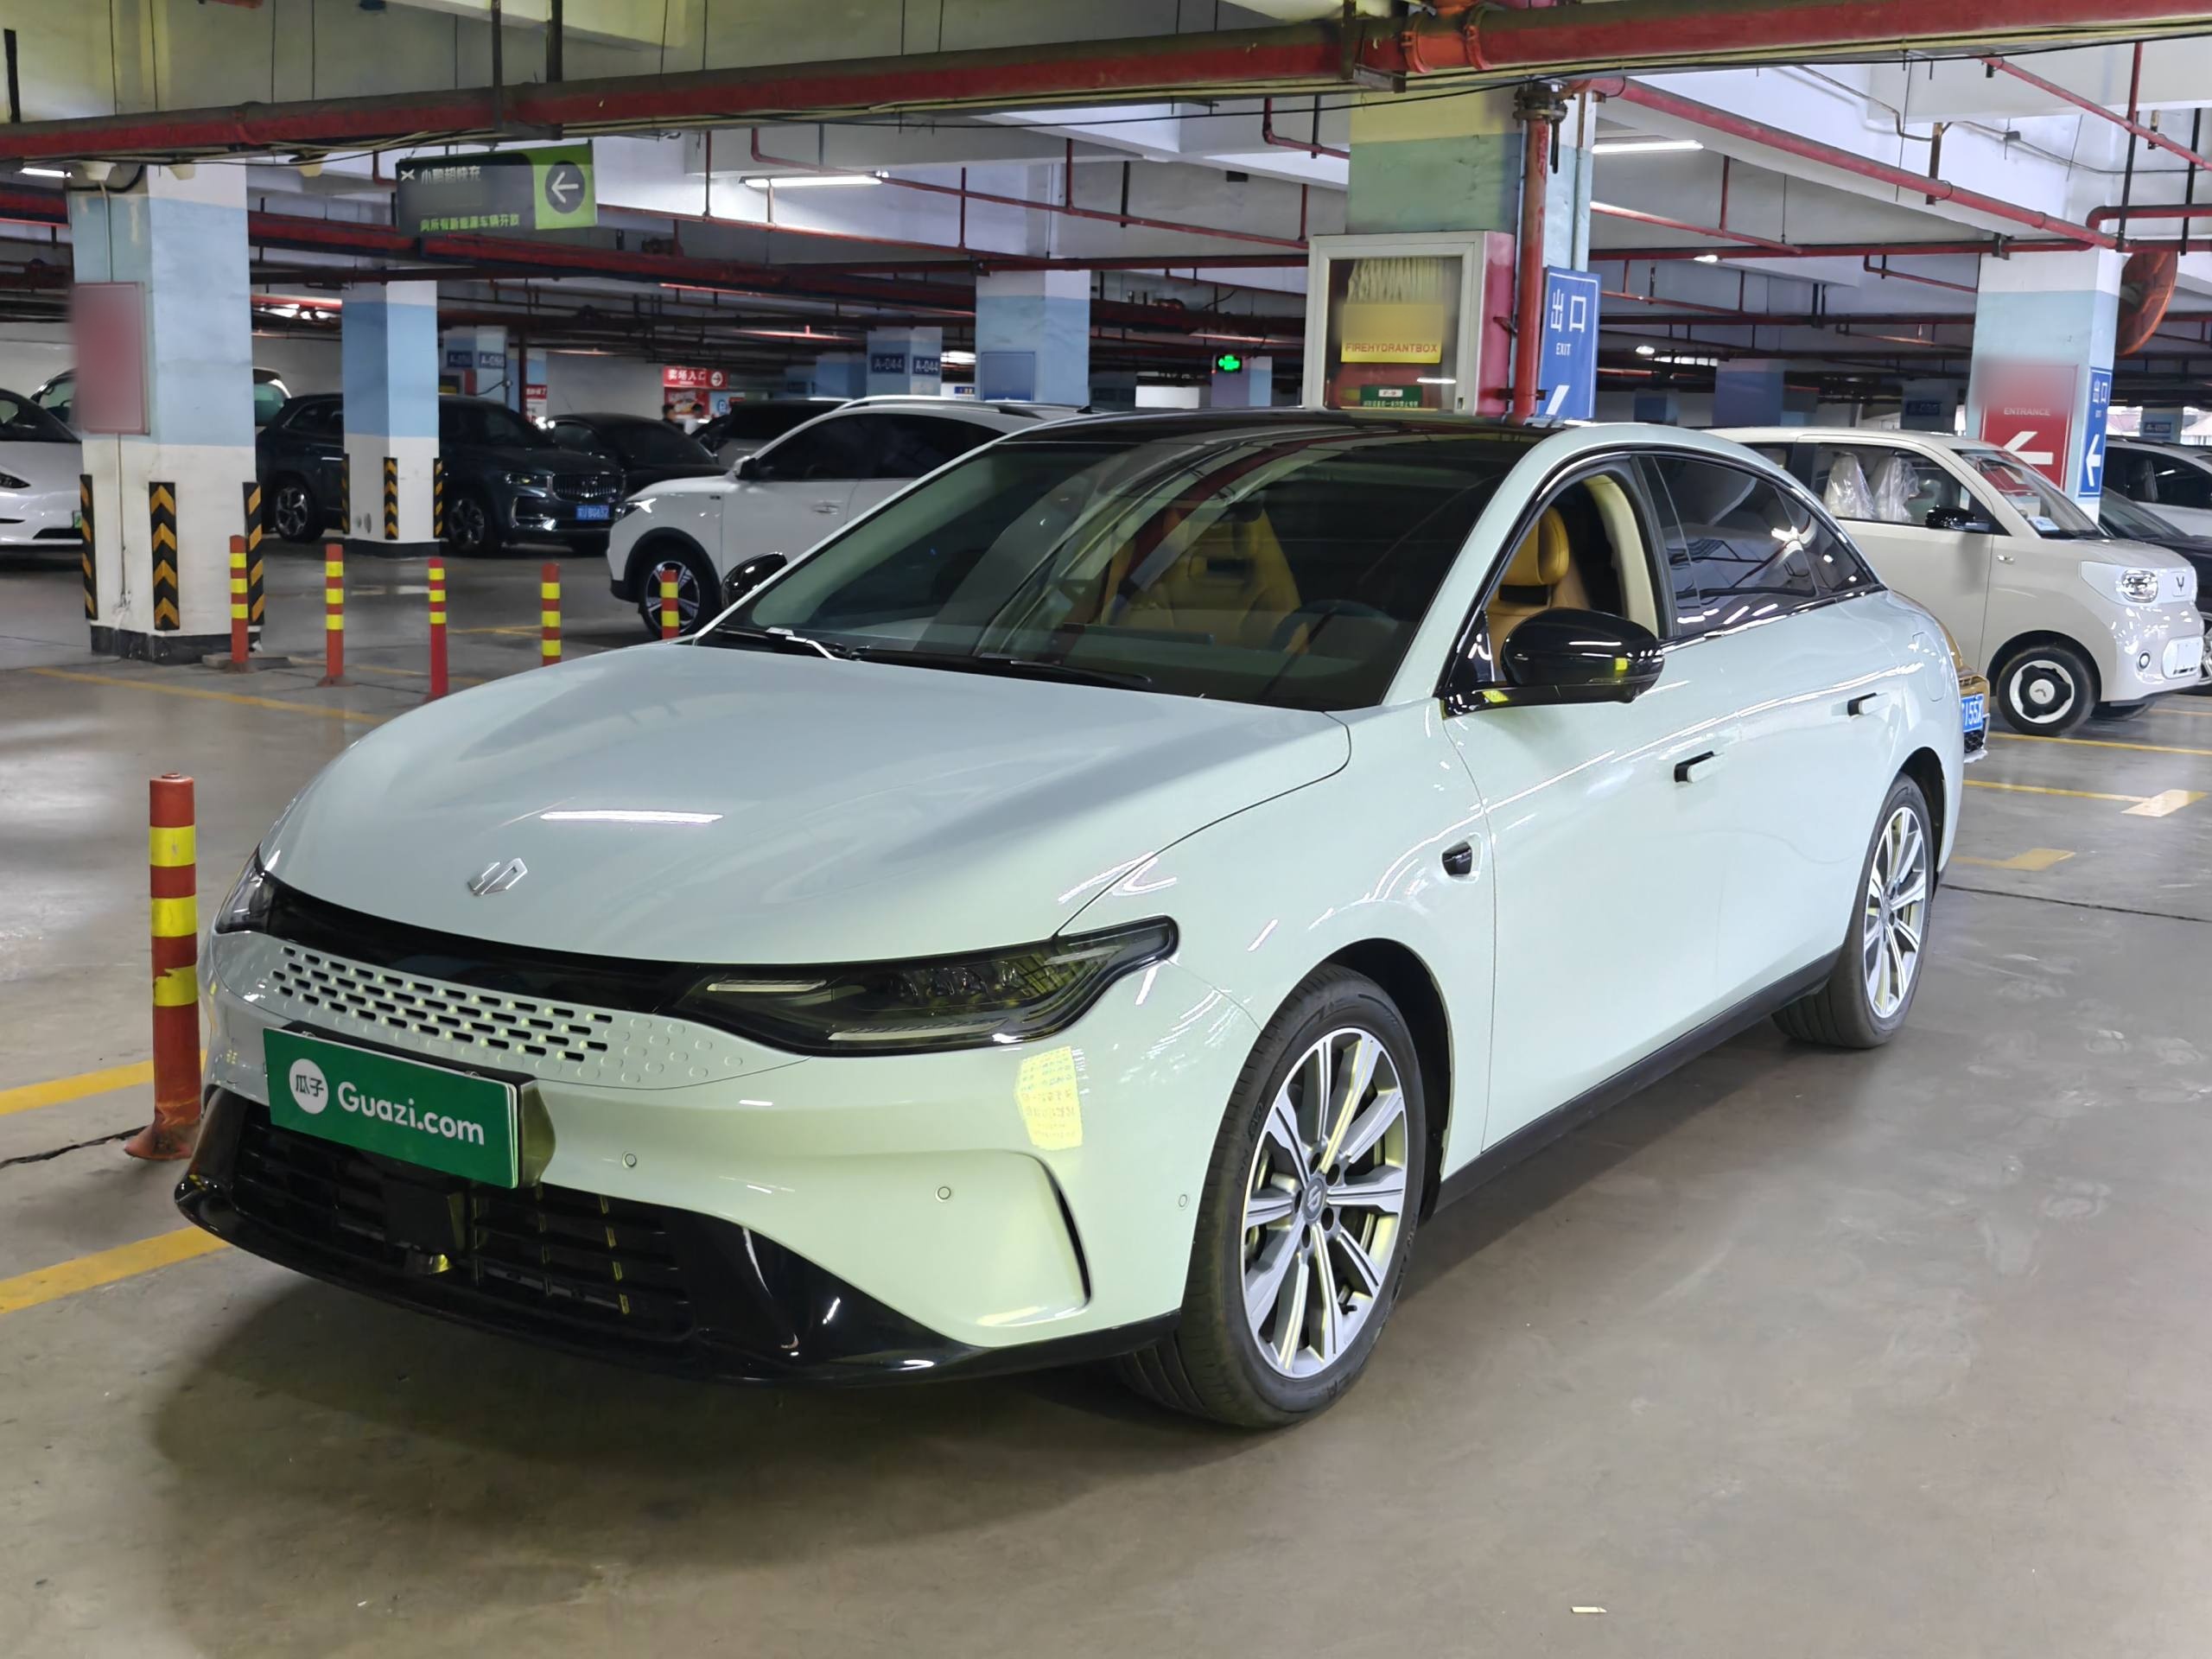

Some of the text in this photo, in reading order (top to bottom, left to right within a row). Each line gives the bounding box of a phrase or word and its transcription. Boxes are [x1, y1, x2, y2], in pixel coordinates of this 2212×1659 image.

[1550, 288, 1586, 333] 出口
[1556, 342, 1571, 355] EXIT
[2004, 407, 2050, 416] ENTRANCE
[295, 1074, 325, 1098] 瓜子
[337, 1081, 485, 1146] Guazi.com
